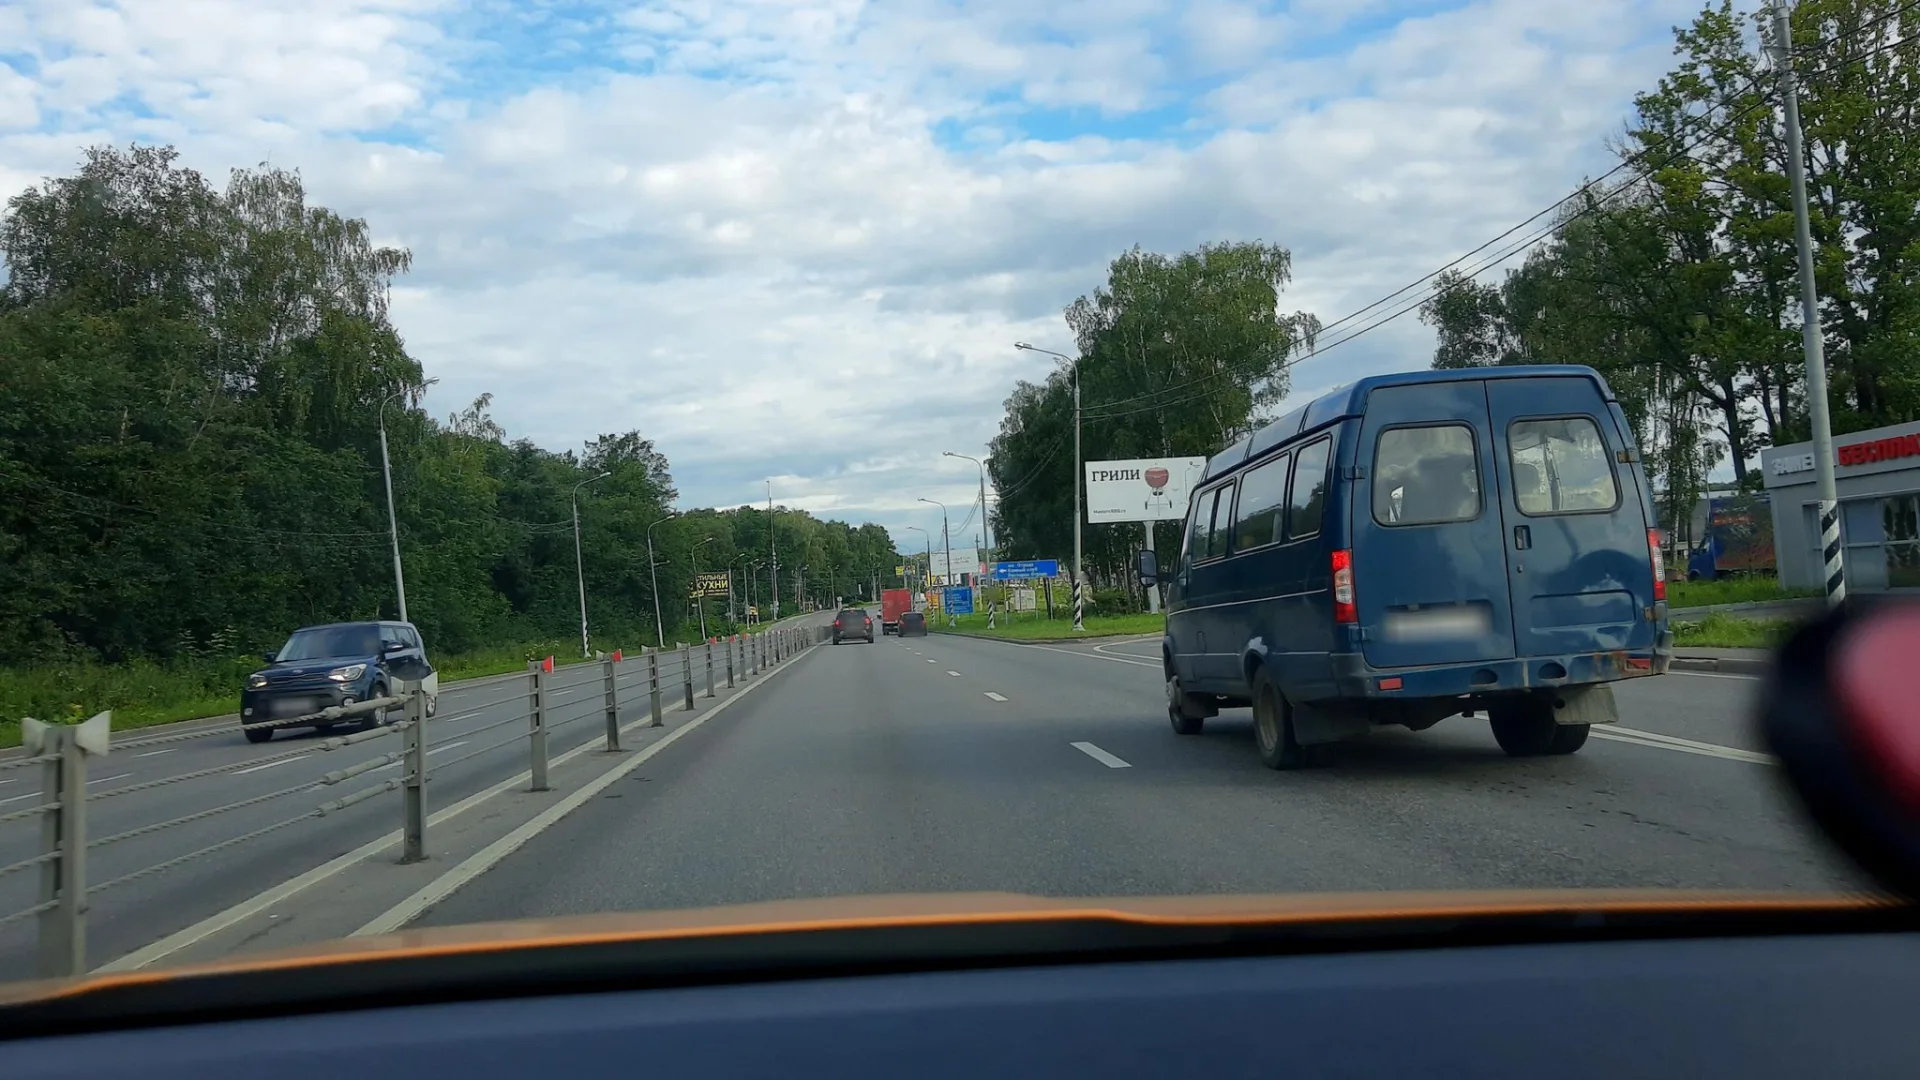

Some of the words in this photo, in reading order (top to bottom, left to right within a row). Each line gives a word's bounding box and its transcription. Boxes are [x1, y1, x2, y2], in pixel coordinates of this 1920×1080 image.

[1838, 433, 1920, 466] БЕСПЛА
[1091, 468, 1141, 482] ГРИЛИ
[696, 580, 728, 590] КУХНИ
